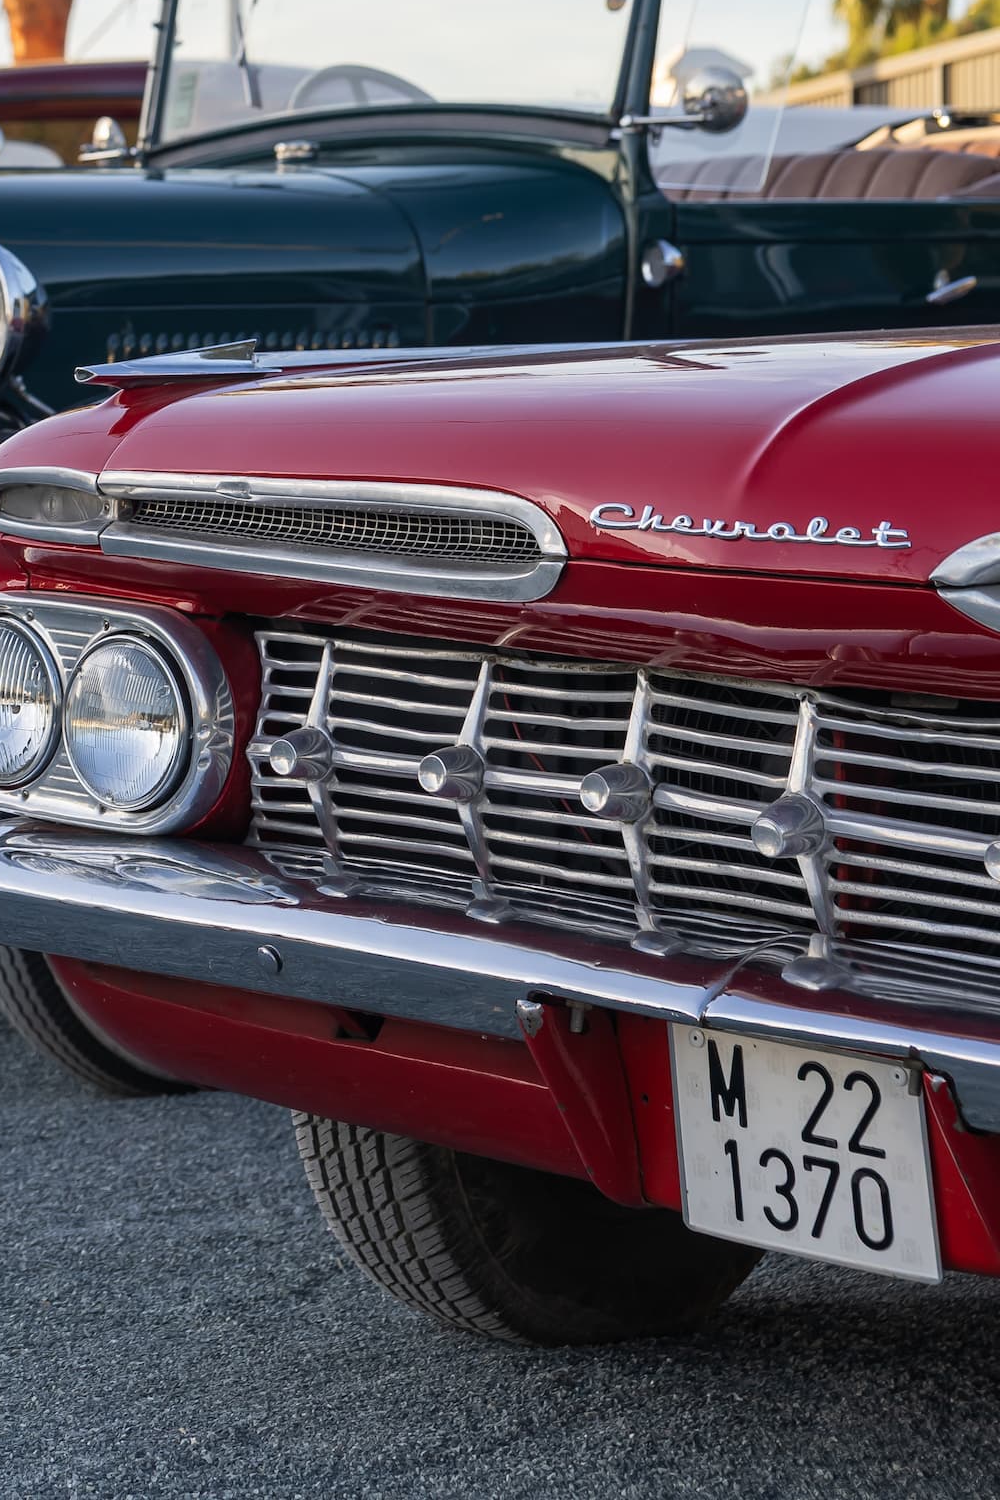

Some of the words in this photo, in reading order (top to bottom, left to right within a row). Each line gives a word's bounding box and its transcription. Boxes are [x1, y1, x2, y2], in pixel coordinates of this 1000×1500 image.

[589, 502, 912, 549] Chevrolet
[707, 1039, 748, 1128] M
[797, 1060, 887, 1160] 22
[723, 1138, 894, 1251] 1370
